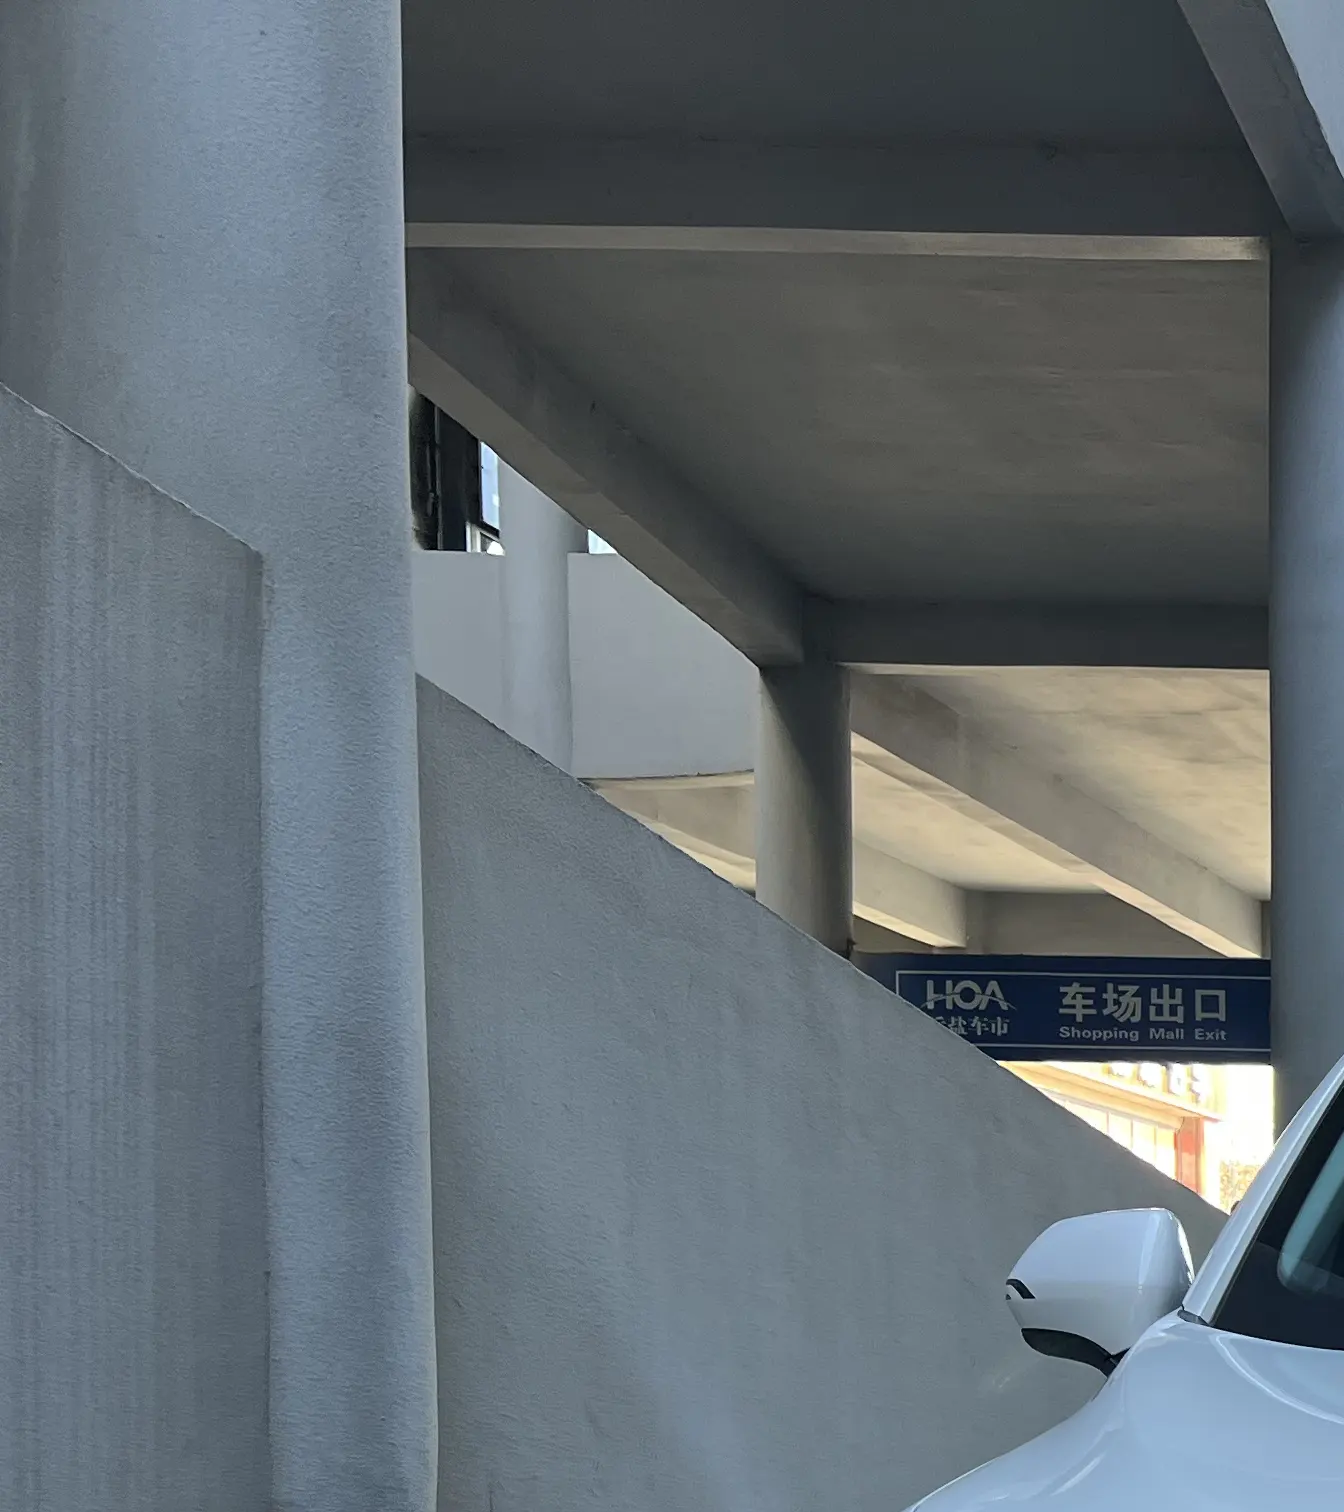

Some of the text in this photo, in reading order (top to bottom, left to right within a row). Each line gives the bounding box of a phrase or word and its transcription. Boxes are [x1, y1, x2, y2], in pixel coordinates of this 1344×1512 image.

[926, 979, 1009, 1010] HOA
[1058, 982, 1227, 1024] 车场出口
[1059, 1026, 1228, 1042] Shopping Mall Exit
